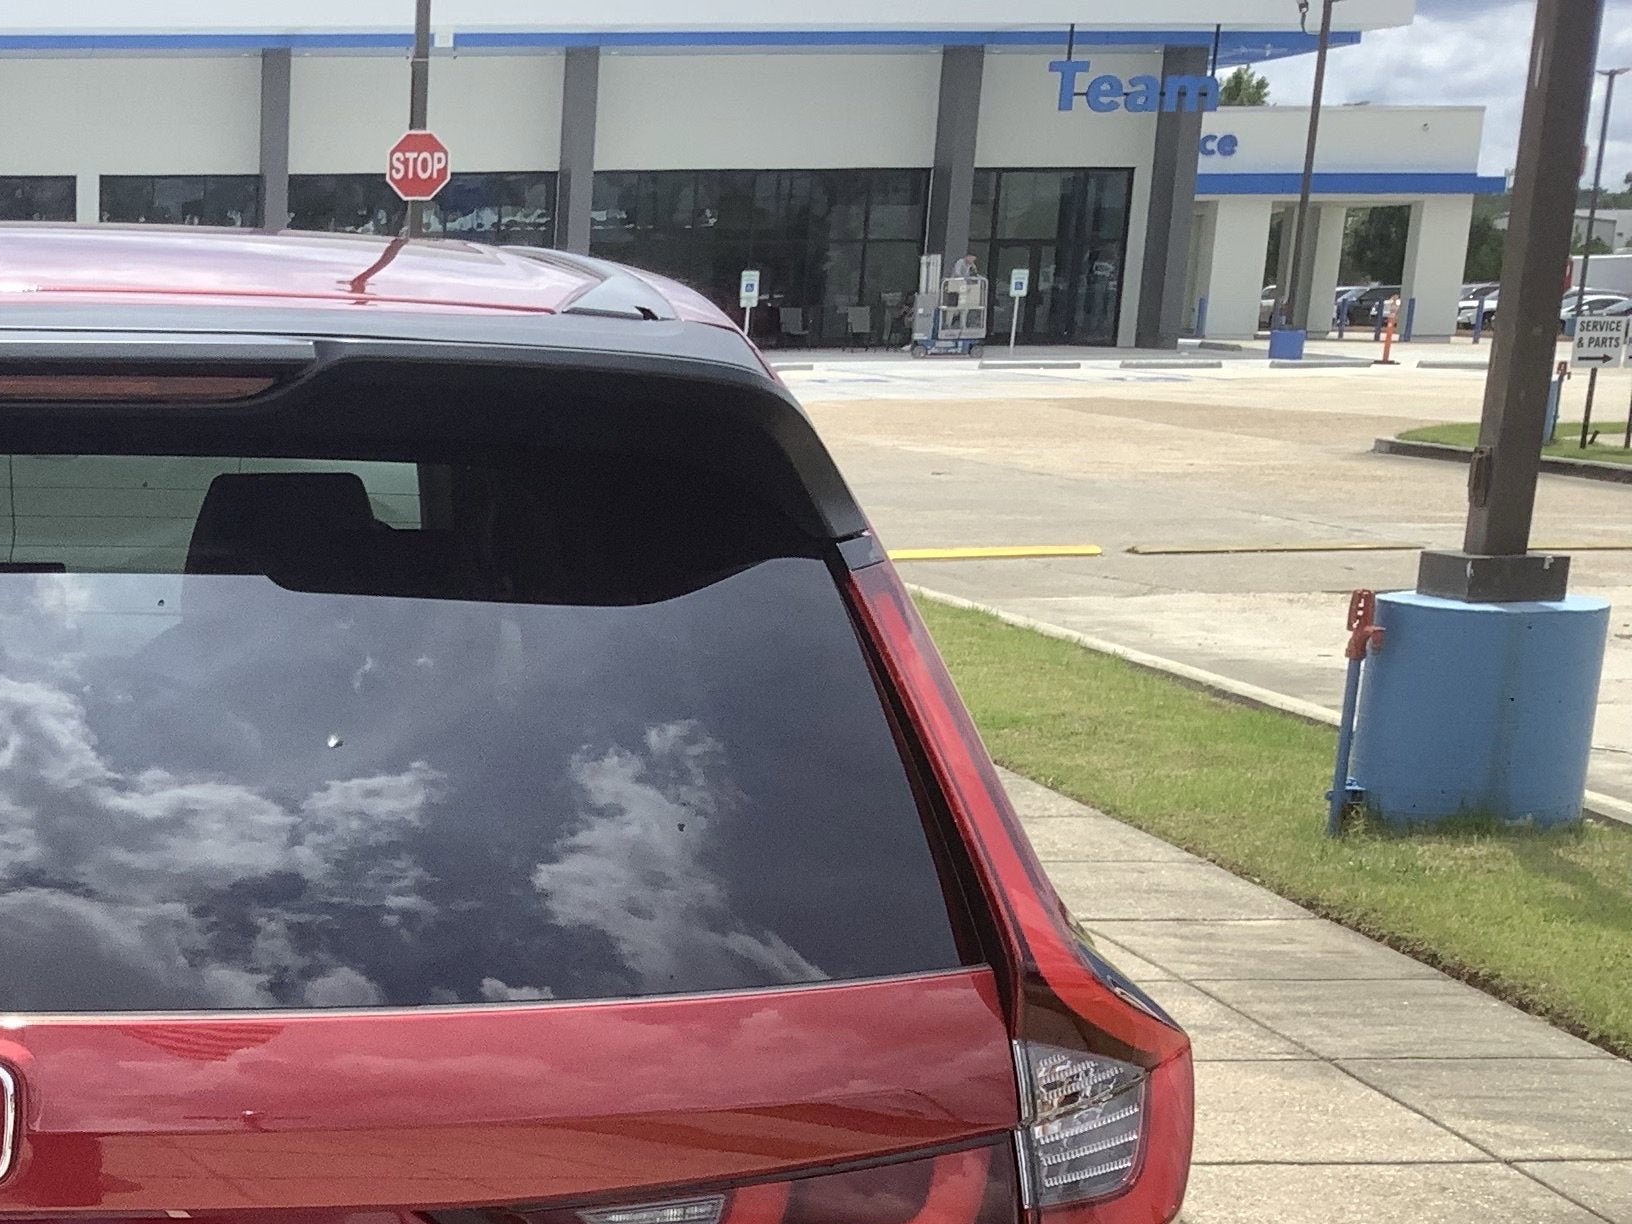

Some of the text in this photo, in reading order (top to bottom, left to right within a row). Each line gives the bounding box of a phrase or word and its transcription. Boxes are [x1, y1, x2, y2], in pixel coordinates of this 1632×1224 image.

[1047, 60, 1219, 113] Team
[391, 151, 447, 180] STOP
[1579, 320, 1622, 332] SERVICE
[1576, 336, 1584, 349] &
[1587, 336, 1620, 349] PARTS
